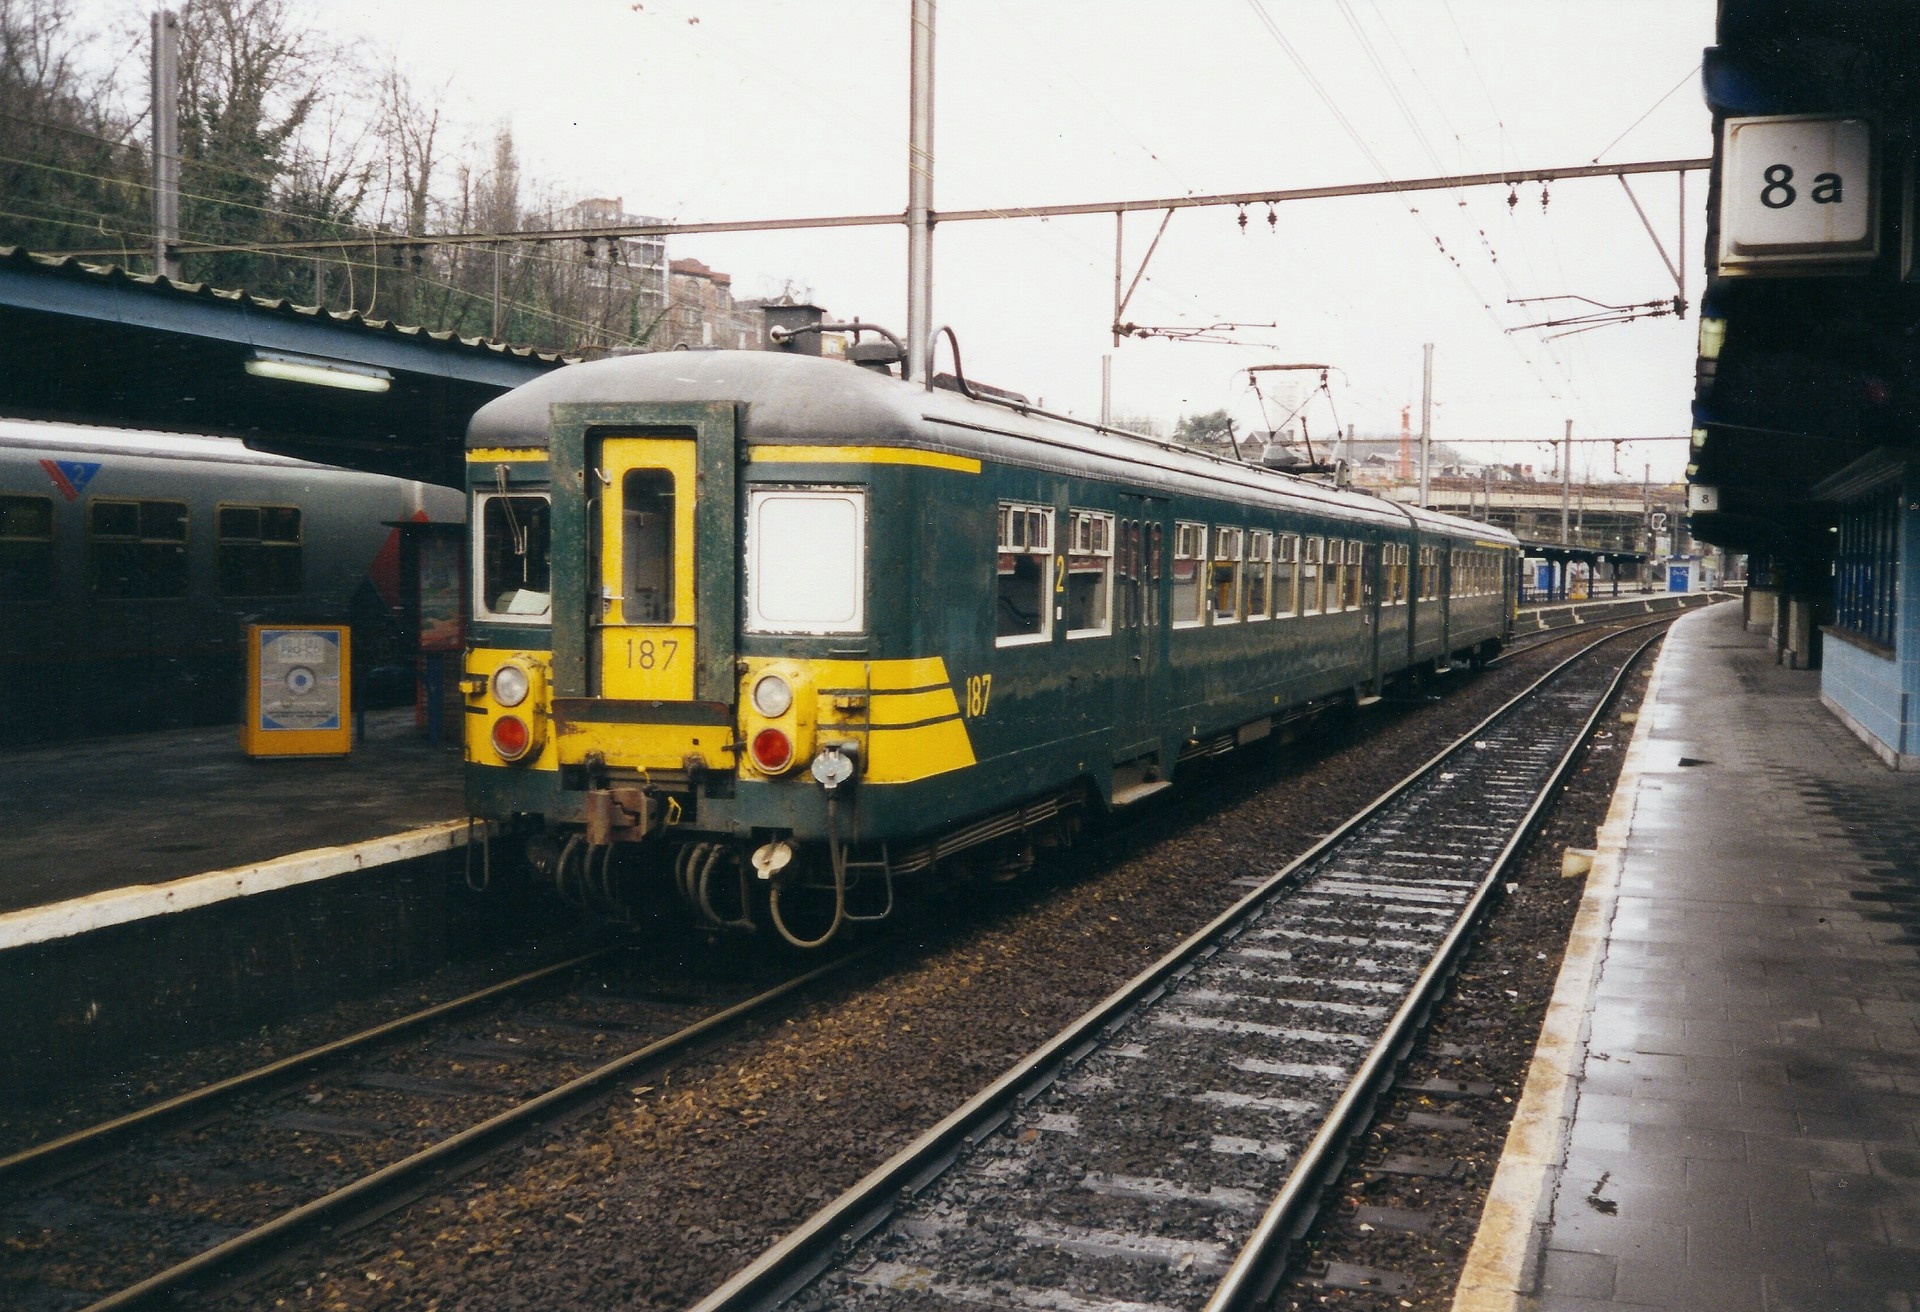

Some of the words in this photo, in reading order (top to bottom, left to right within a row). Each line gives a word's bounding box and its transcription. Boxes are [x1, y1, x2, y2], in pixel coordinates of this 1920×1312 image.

[73, 464, 84, 485] 2
[1701, 494, 1709, 504] 8
[1056, 555, 1064, 592] 2
[1207, 561, 1213, 590] 2
[627, 639, 678, 671] 187
[966, 674, 992, 718] 187
